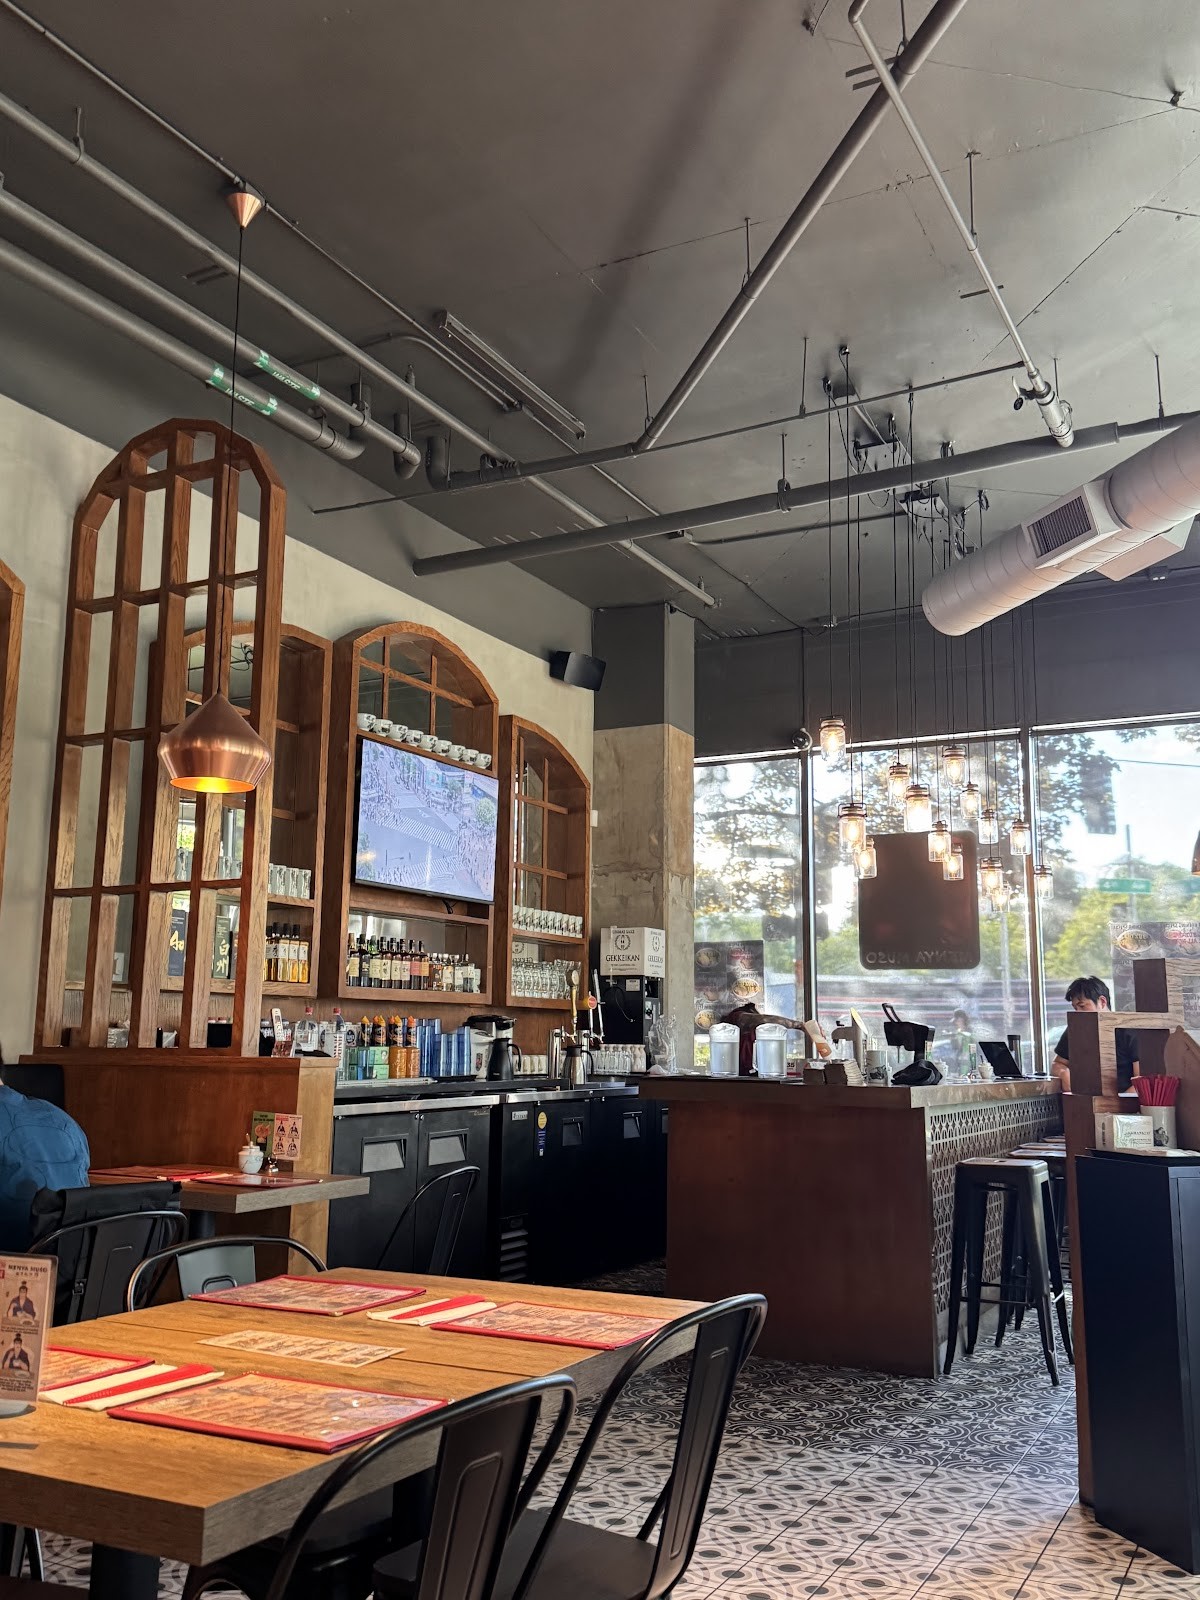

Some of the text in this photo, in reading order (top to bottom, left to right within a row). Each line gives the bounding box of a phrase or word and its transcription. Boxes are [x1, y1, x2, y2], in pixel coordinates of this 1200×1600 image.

[272, 371, 300, 390] WASTE
[225, 388, 255, 406] WASTE
[216, 939, 230, 977] 白州
[605, 954, 640, 962] GEKKEIKAN
